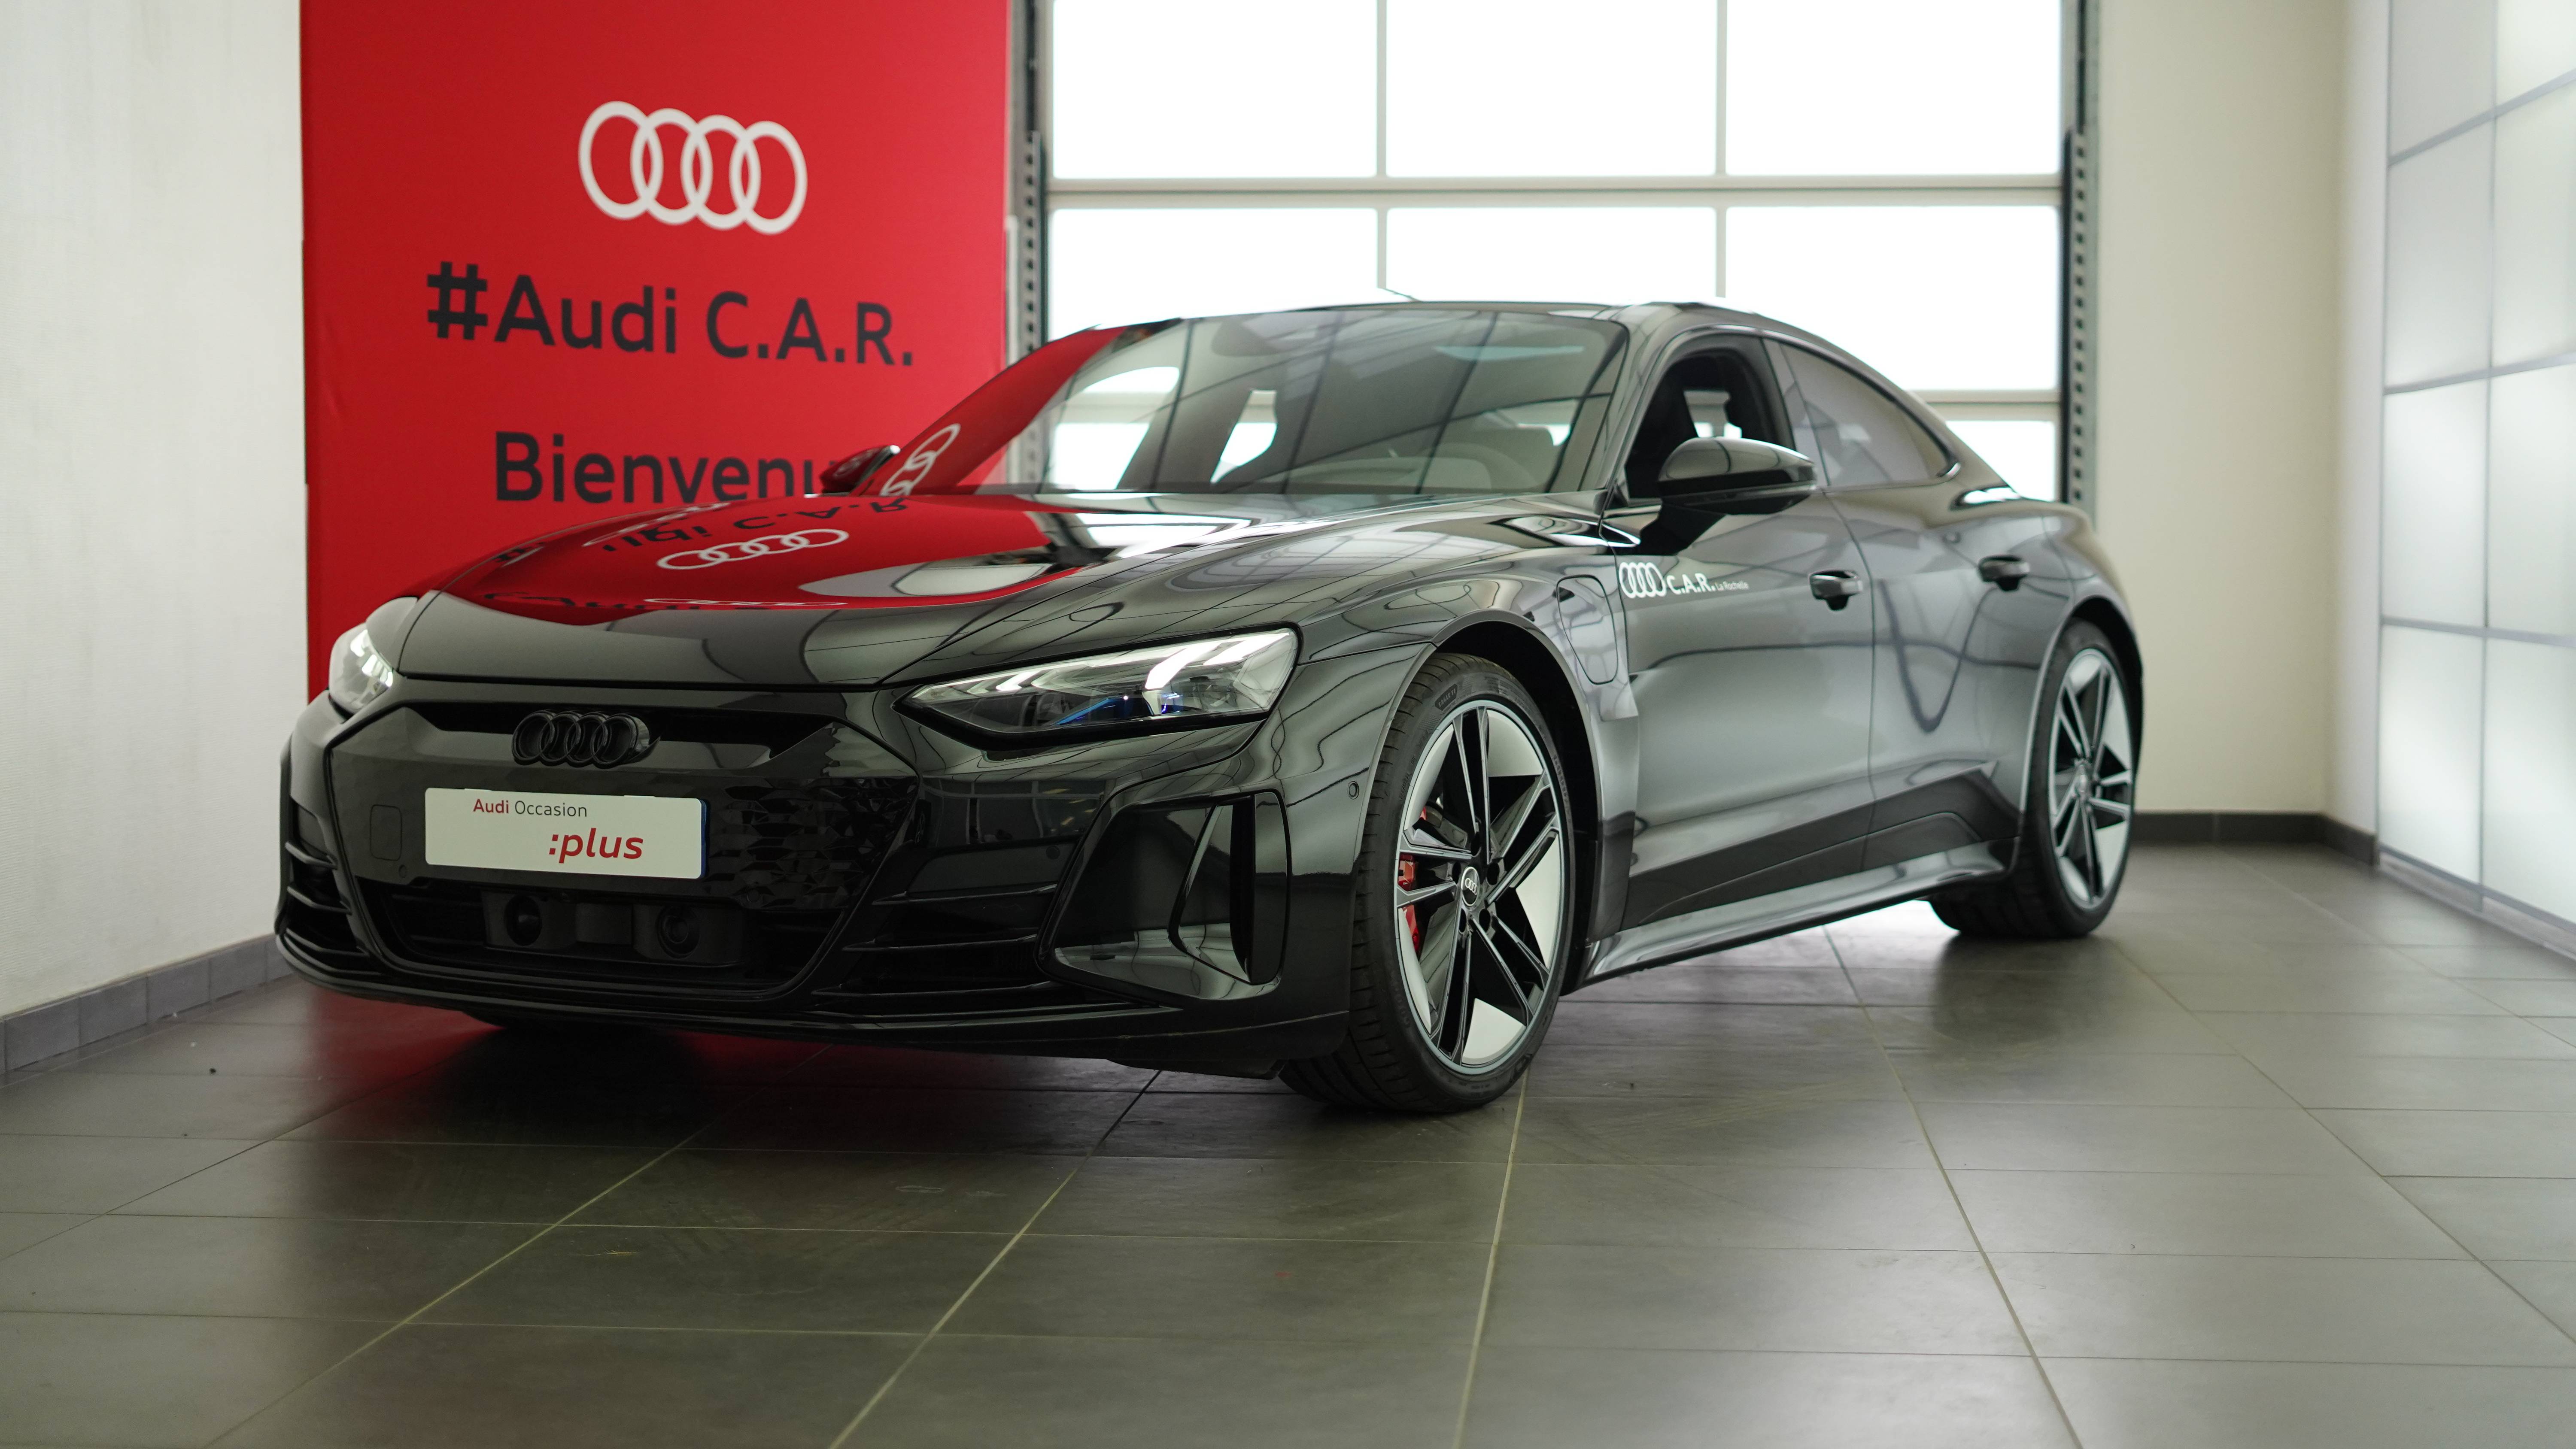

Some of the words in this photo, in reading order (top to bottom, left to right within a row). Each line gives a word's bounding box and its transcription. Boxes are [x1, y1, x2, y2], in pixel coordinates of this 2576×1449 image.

[427, 261, 676, 354] #Audi
[705, 291, 913, 366] C.A.R.
[1666, 573, 1716, 594] C.A.R.
[473, 798, 509, 814] Audi
[515, 800, 587, 817] Occasion
[549, 828, 644, 864] :plus
